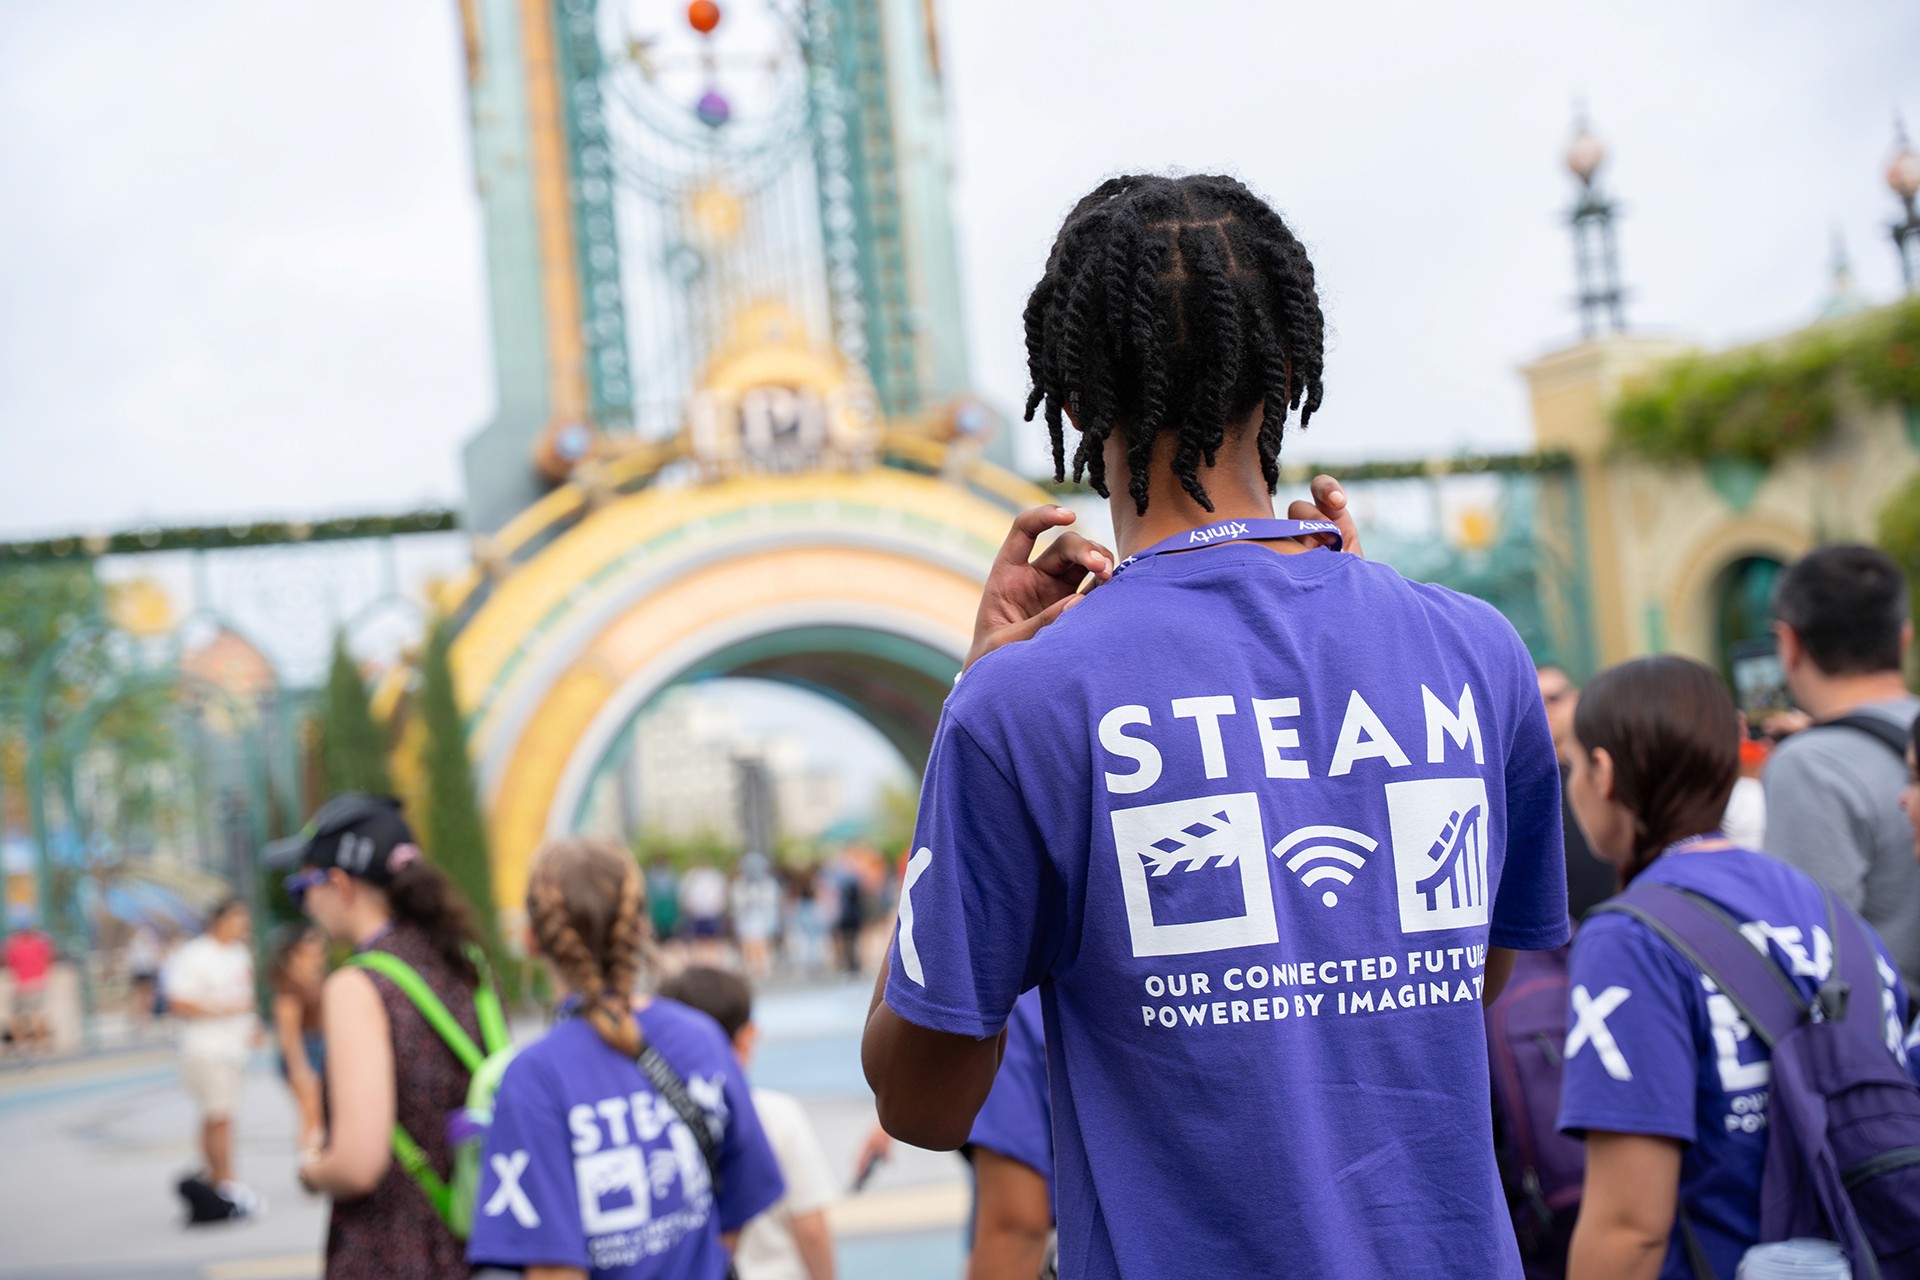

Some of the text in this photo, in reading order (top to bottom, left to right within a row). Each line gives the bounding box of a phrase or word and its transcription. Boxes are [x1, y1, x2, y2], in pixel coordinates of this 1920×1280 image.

[1189, 521, 1249, 543] xfinity
[1099, 683, 1485, 794] STEAM
[1145, 972, 1212, 998] OUR
[1223, 956, 1398, 991] CONNECTED
[1141, 997, 1290, 1028] POWERED
[1293, 993, 1325, 1018] BY
[1564, 984, 1634, 1083] X
[483, 1149, 541, 1229] X
